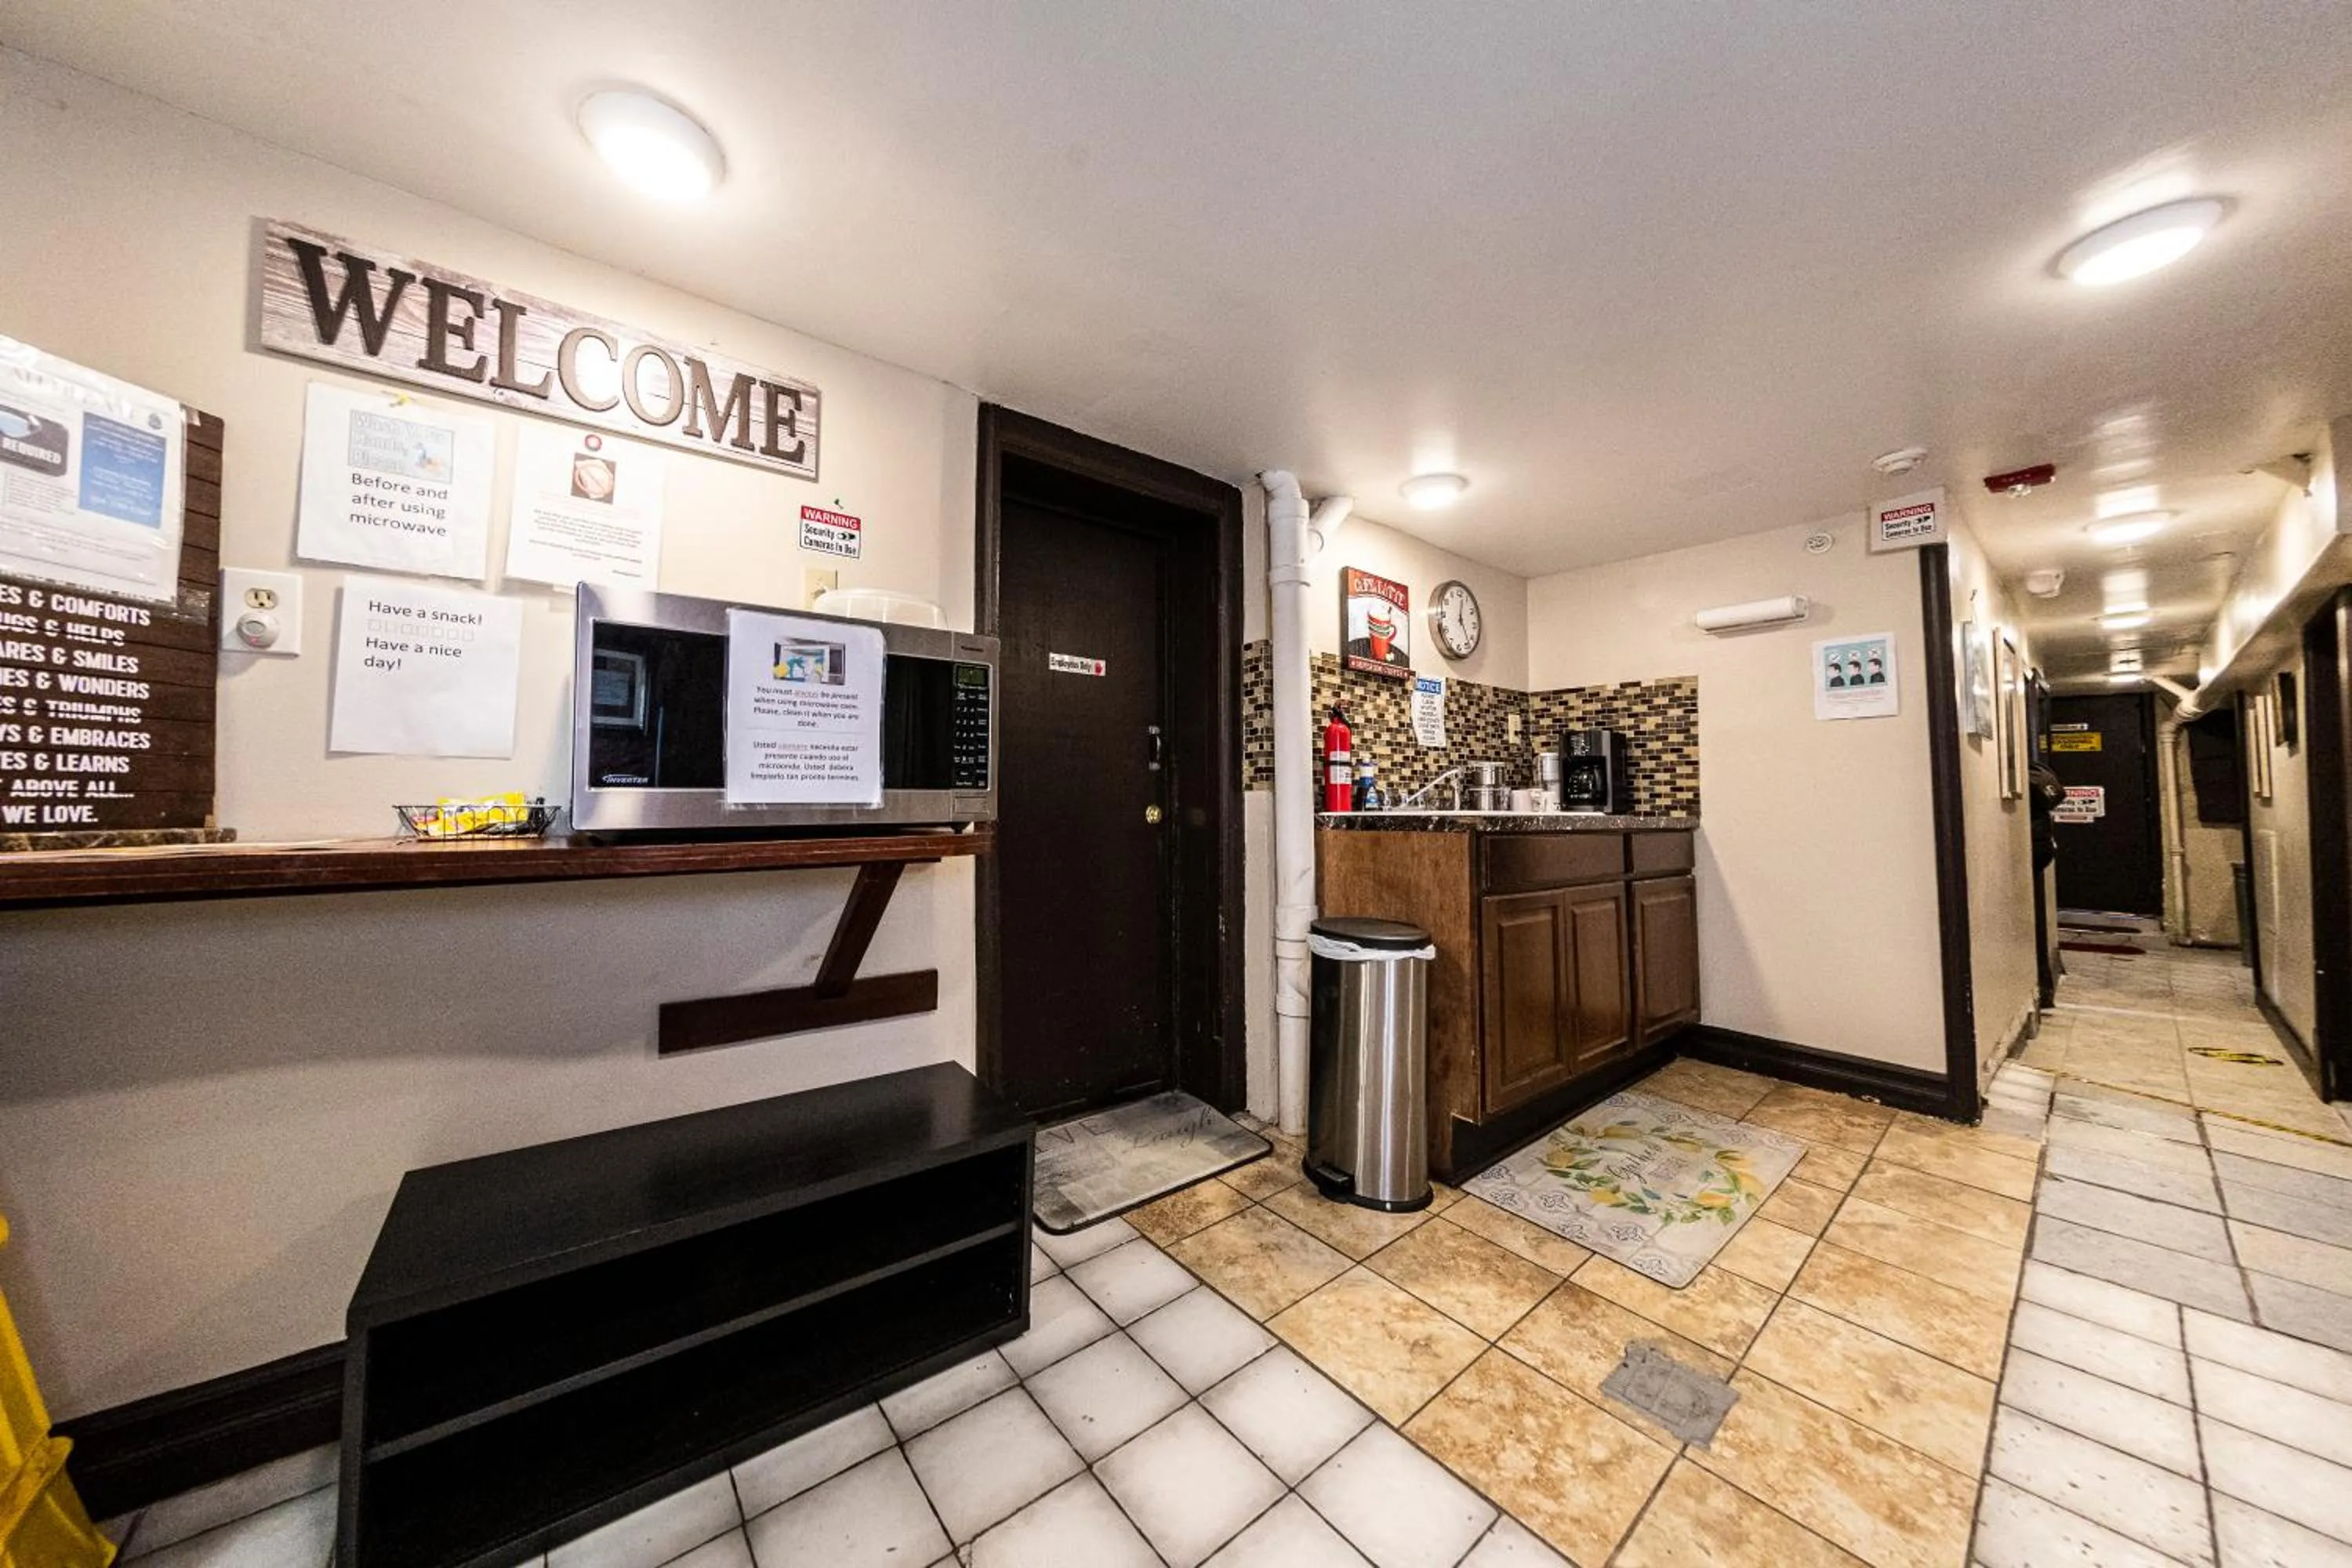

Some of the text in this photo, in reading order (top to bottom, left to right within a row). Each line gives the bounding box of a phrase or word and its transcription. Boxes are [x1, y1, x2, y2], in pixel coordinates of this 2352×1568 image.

[287, 238, 807, 463] WELCOME
[351, 473, 448, 500] Before and
[351, 493, 446, 520] after using
[803, 507, 858, 529] WARNING
[1884, 504, 1932, 521] WARNING
[350, 512, 446, 537] microwave
[804, 523, 835, 540] Security
[1886, 521, 1911, 530] Security
[1886, 528, 1911, 538] Cameras
[804, 535, 835, 550] Cameras
[28, 590, 45, 609] &
[51, 593, 151, 626] COMFORTS
[368, 600, 483, 626] Have a snack!
[45, 618, 60, 637] &
[66, 622, 125, 647] HELPS
[366, 637, 462, 659] Have a nice
[52, 646, 67, 665] &
[73, 649, 139, 674] SMILES
[364, 654, 401, 672] day!
[36, 671, 52, 690] &
[58, 673, 150, 700] WONDERS
[0, 695, 142, 724] S & TRIUMPHS
[28, 725, 44, 744] &
[50, 727, 151, 749] EMBRACES
[0, 751, 129, 774] ES & LEARNS
[10, 779, 78, 798] ABOVE
[2, 804, 99, 824] WE LOVE.
